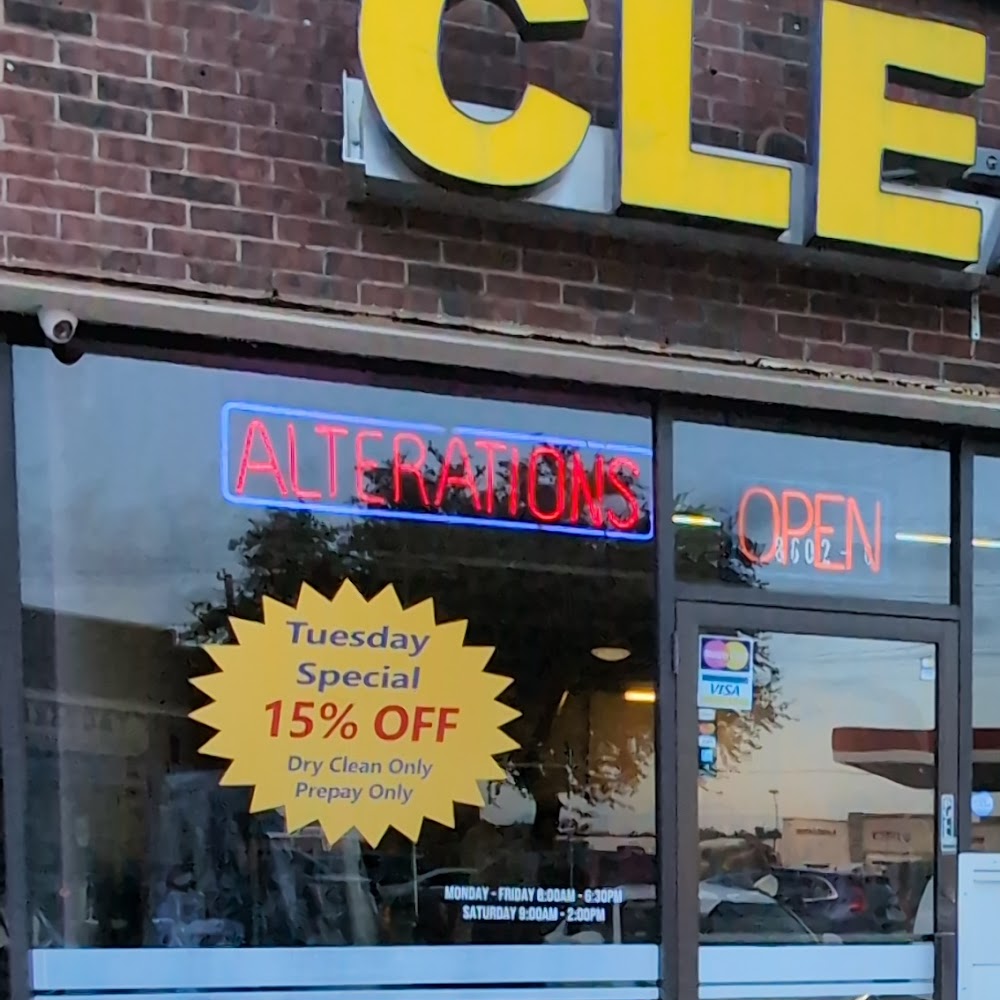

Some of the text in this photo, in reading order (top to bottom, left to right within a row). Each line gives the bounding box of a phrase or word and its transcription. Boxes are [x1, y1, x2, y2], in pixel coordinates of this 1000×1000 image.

[234, 418, 642, 532] ALTERATIONS
[737, 485, 882, 575] OPEN
[286, 620, 431, 657] Tuesday
[296, 662, 421, 692] Special
[710, 682, 741, 697] VISA
[265, 699, 460, 743] 15% OFF
[288, 755, 433, 779] Dry Clean Only
[295, 781, 414, 805] Prepay Only
[444, 885, 490, 902] MONDAY
[498, 886, 536, 903] FRIDAY
[462, 905, 517, 921] SATURDAY
[566, 906, 606, 923] 2:00PM
